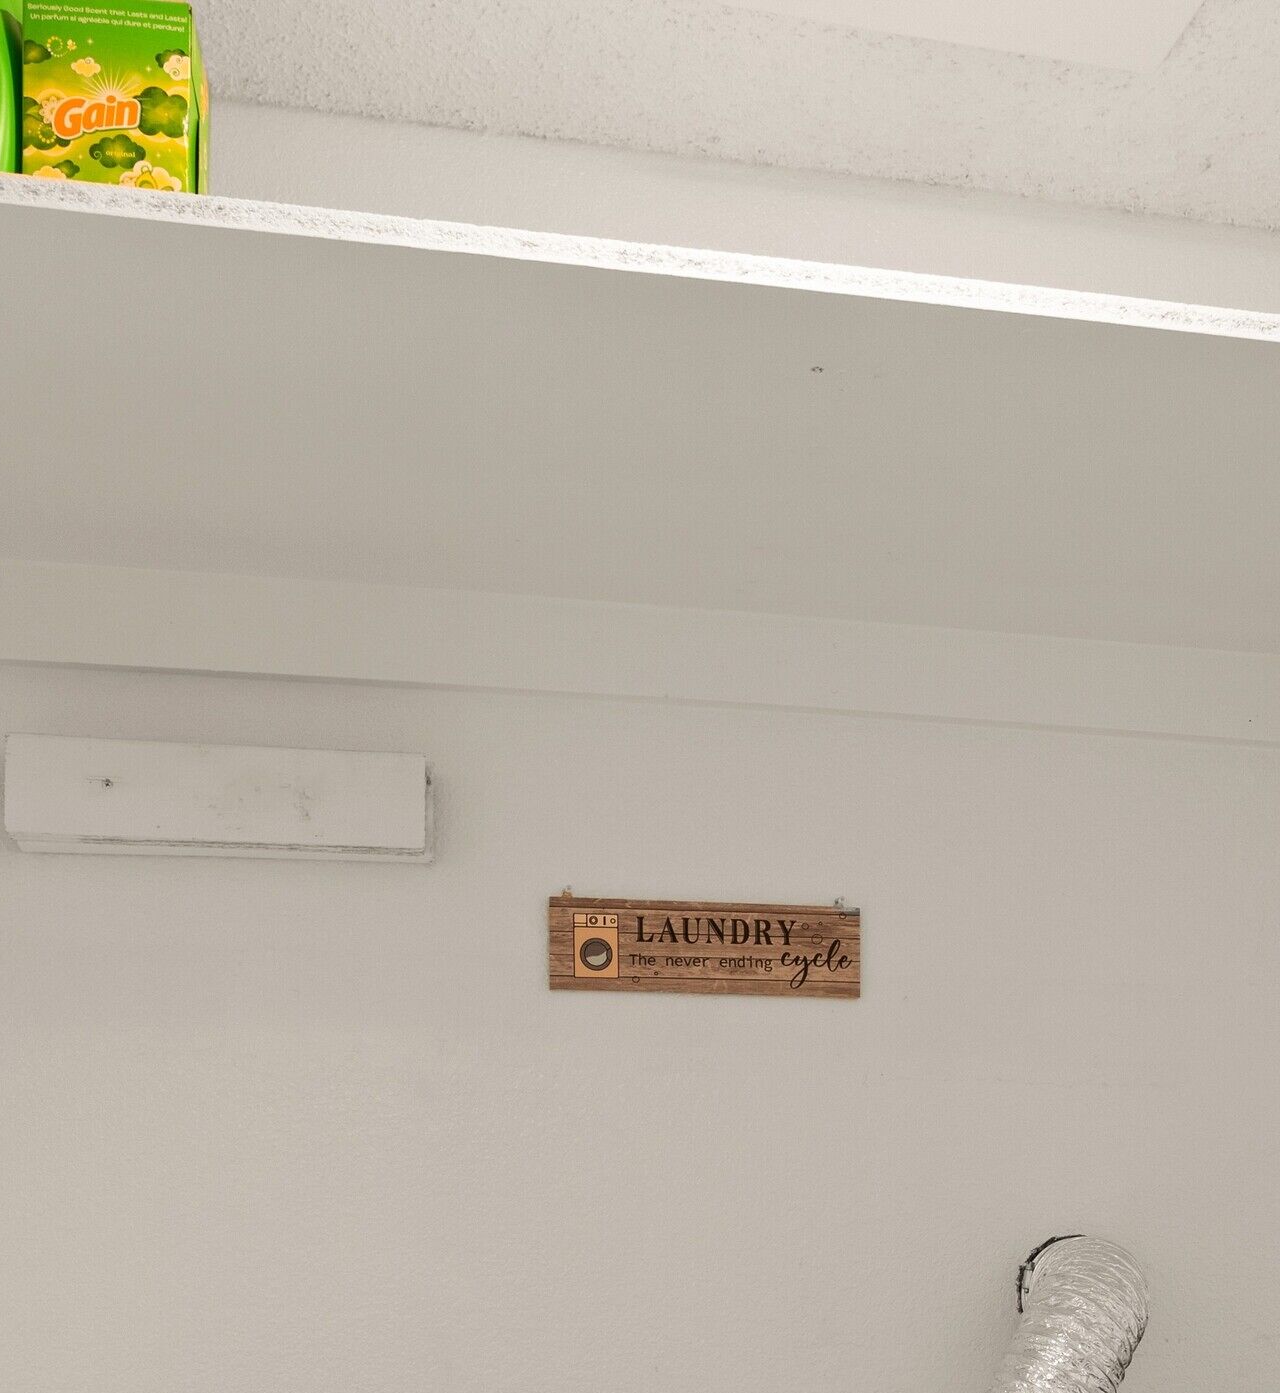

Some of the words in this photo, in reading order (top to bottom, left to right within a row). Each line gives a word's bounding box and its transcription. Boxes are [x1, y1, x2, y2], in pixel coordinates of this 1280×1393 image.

[27, 3, 63, 13] Seriously
[85, 7, 108, 15] Scent
[127, 10, 148, 19] Lasts
[149, 12, 164, 20] and
[165, 14, 188, 23] Lasts!
[41, 14, 69, 23] parfum
[78, 16, 110, 25] agréable
[111, 18, 123, 27] qui
[124, 19, 141, 28] dure
[53, 94, 140, 138] Gain
[636, 915, 797, 946] LAUNDRY
[629, 953, 656, 967] The
[665, 956, 710, 968] never
[719, 955, 773, 973] ending
[780, 938, 853, 990] cycle
